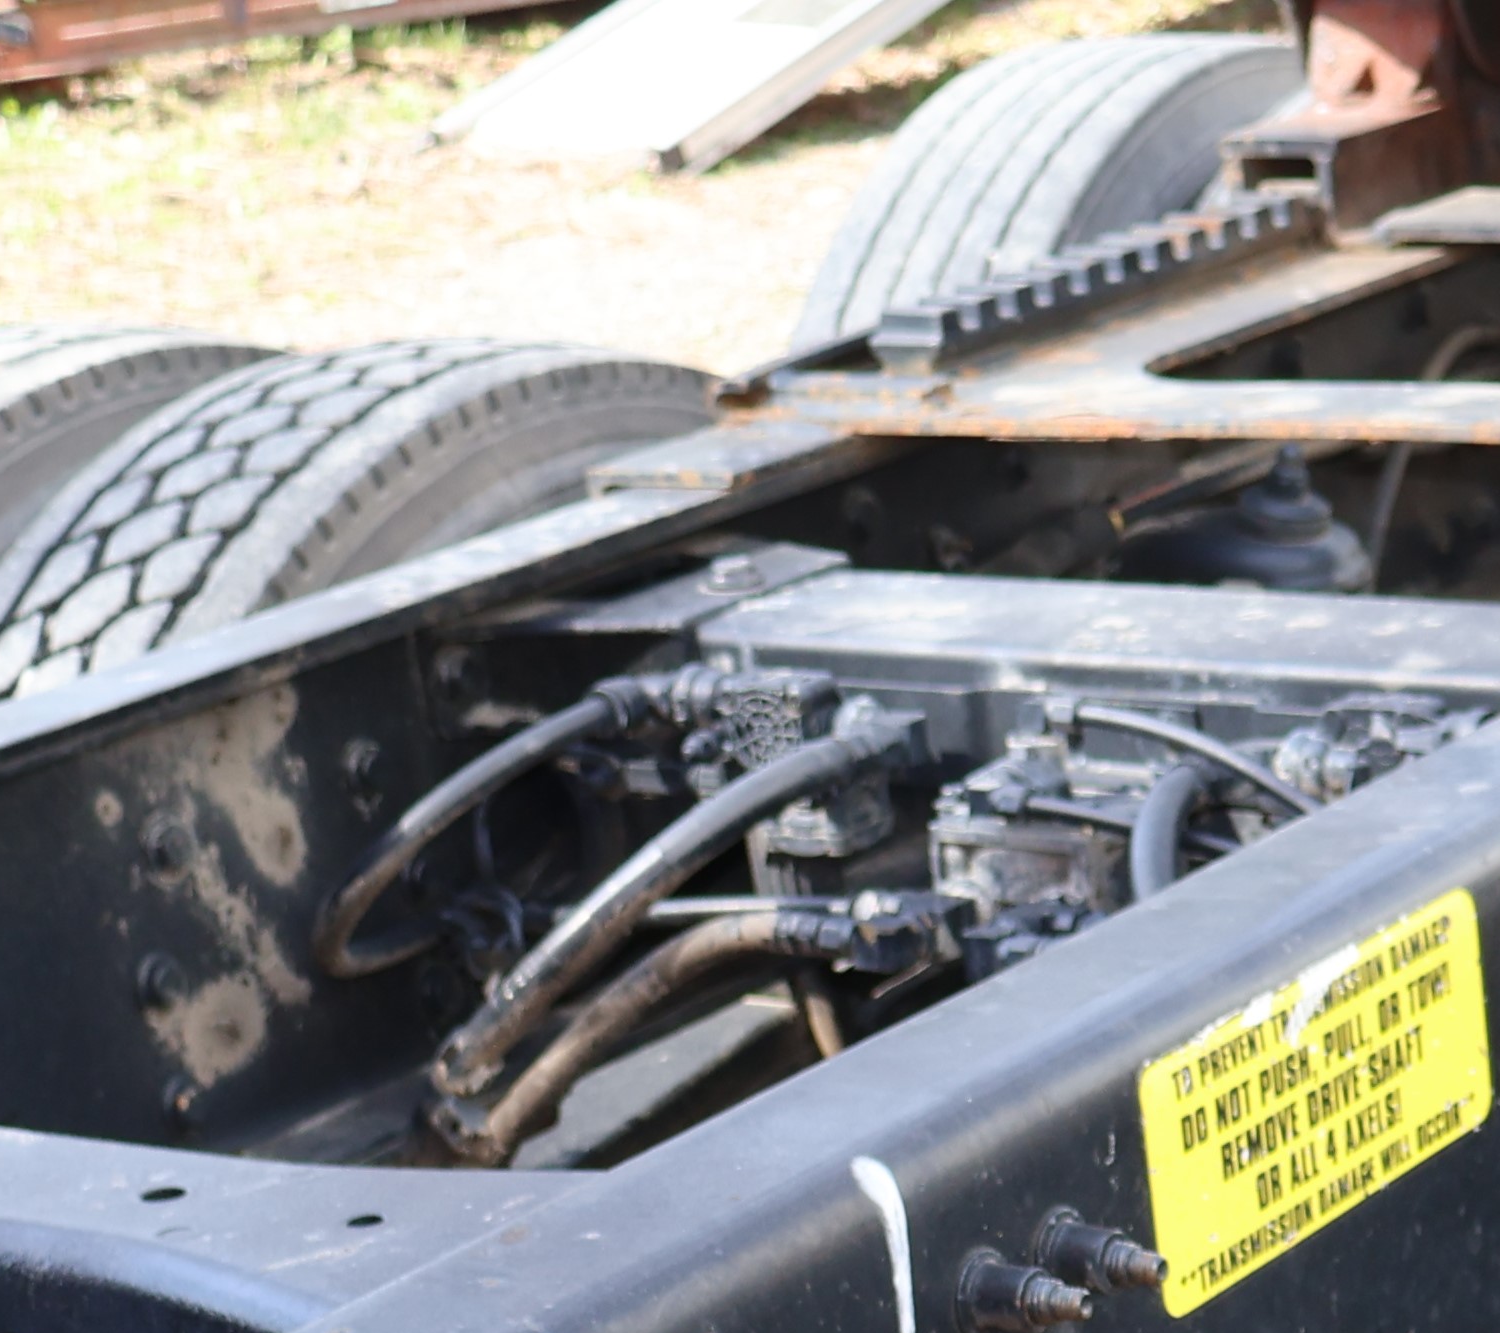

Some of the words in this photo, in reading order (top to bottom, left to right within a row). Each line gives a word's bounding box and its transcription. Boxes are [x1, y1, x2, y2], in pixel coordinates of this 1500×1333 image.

[1181, 1104, 1208, 1153] DO
[1214, 1078, 1253, 1133] NOT
[1259, 1045, 1318, 1104] PUSH,
[1323, 1012, 1373, 1067] PULL,
[1377, 990, 1400, 1034] OR
[1198, 1023, 1266, 1086] PREVENT
[1221, 1102, 1300, 1181] REMOVE
[1306, 1066, 1363, 1129] DRIVE
[1367, 1025, 1424, 1090] SHAFT
[1255, 1162, 1282, 1212] OR
[1289, 1139, 1318, 1190] ALL
[1324, 1127, 1338, 1168] 4
[1344, 1087, 1404, 1155] AXELS!
[1380, 1132, 1411, 1175] WILL
